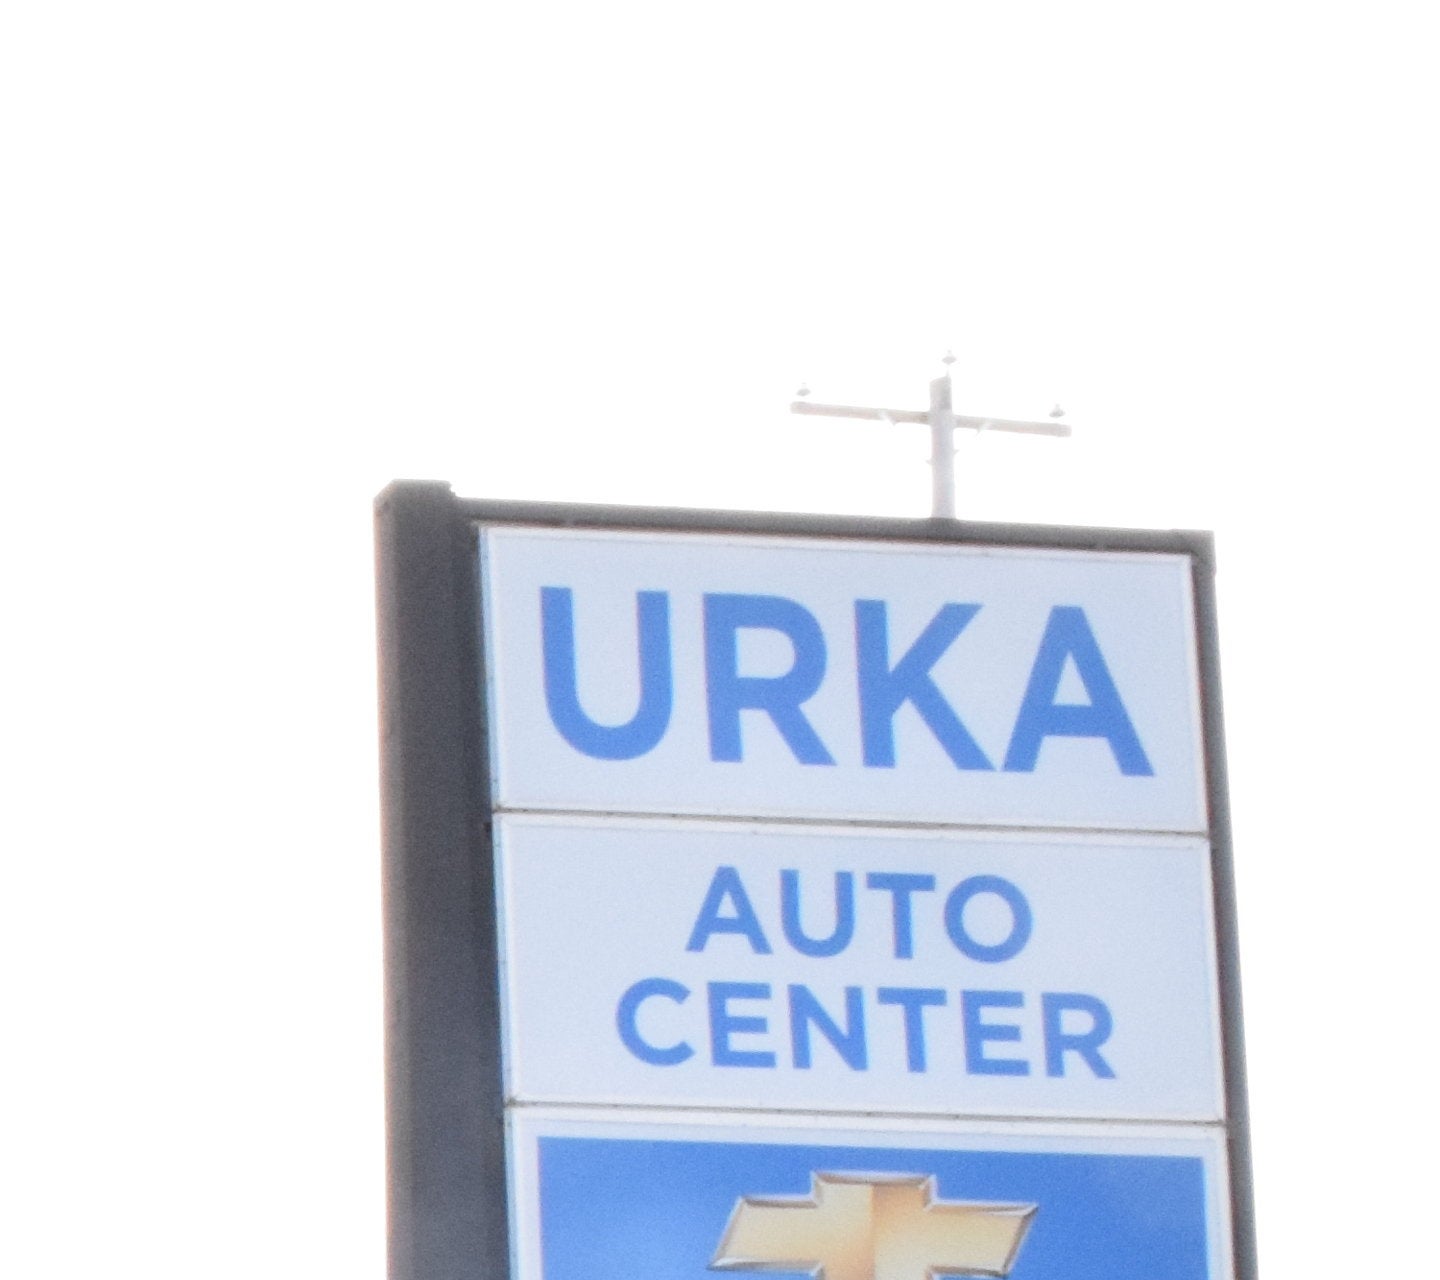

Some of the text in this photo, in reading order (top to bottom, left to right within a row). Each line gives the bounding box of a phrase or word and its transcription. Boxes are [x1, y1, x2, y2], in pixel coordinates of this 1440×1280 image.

[541, 586, 1155, 777] URKA
[687, 865, 1035, 964] AUTO
[617, 977, 1115, 1079] CENTER
